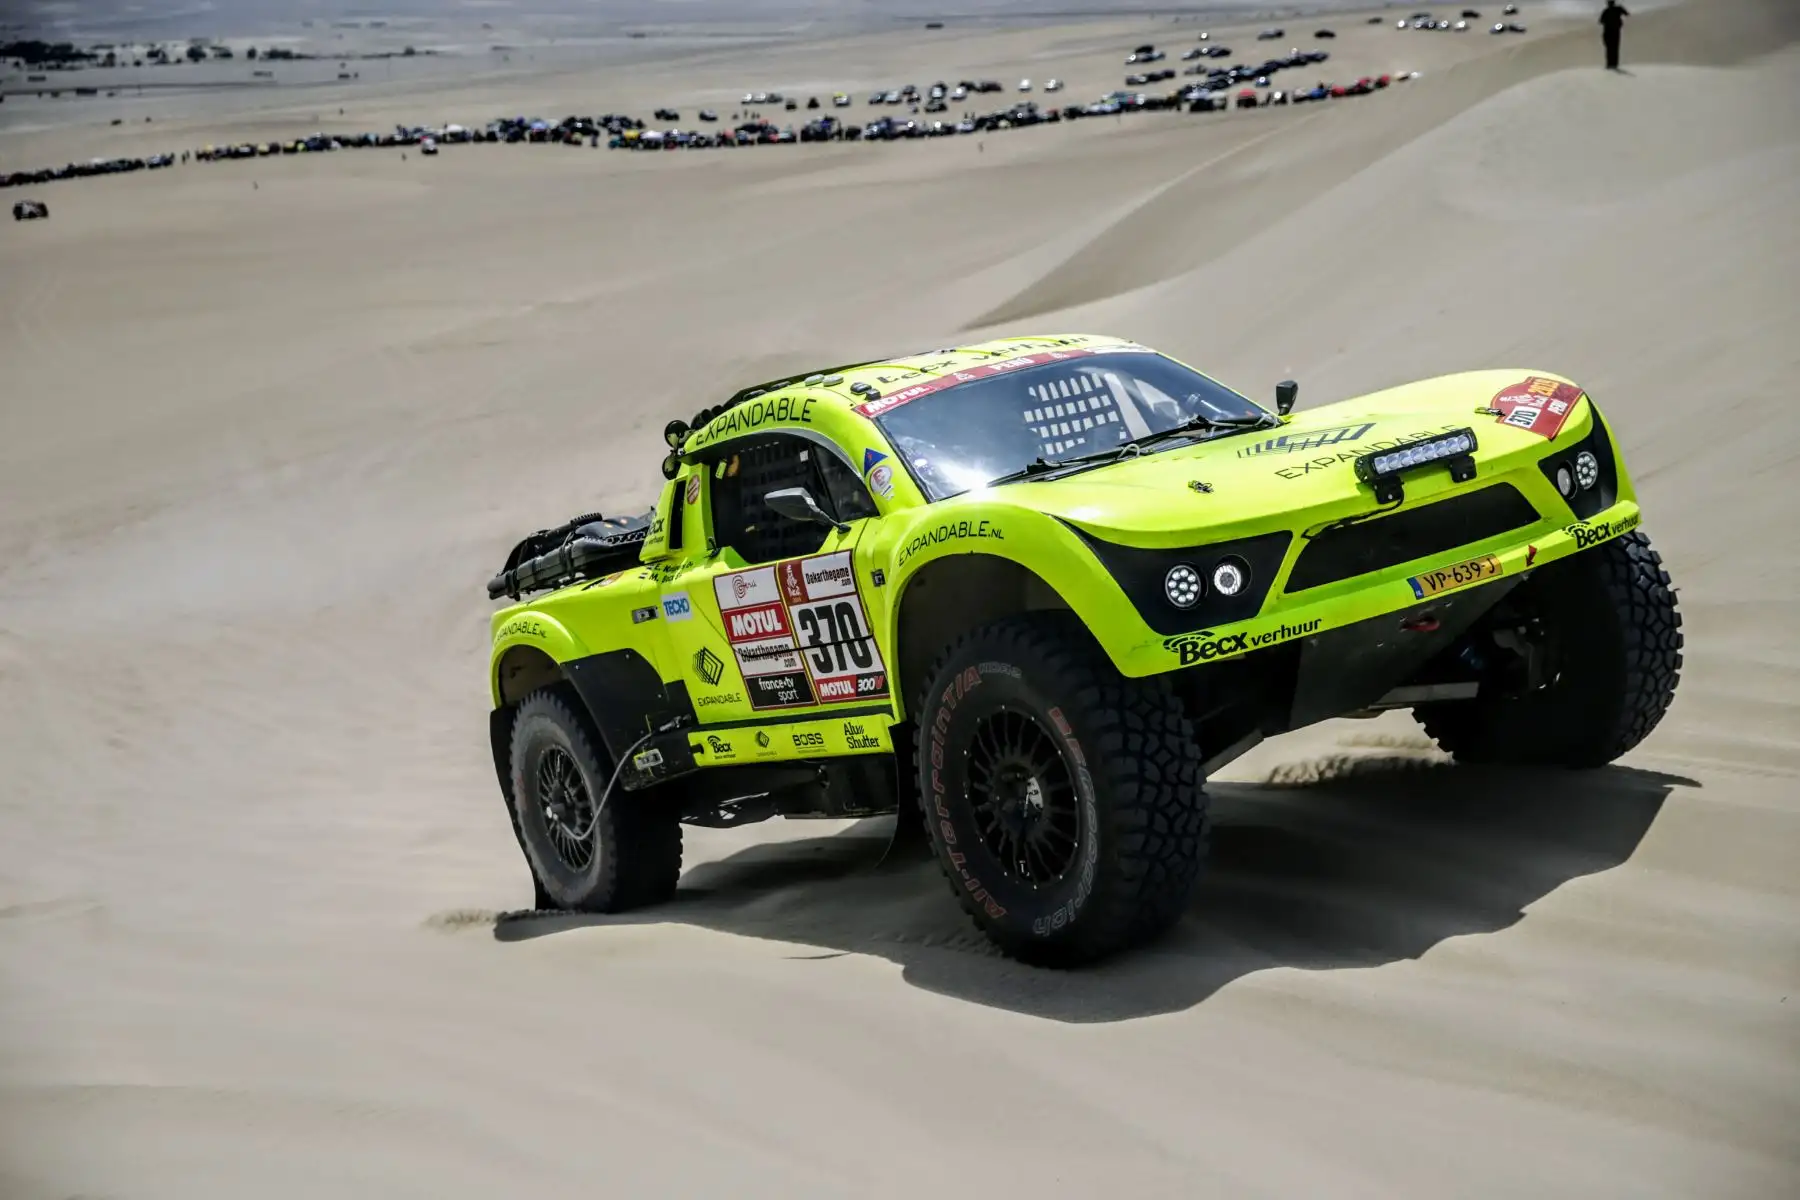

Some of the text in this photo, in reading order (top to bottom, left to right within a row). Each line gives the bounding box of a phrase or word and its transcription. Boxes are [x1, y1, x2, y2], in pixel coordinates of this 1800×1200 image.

[866, 386, 931, 414] MOTUL
[696, 397, 817, 446] EXPANDABLE
[1508, 410, 1538, 427] 370
[898, 520, 1005, 567] EXPANDABLE.NL
[1573, 522, 1611, 549] Becx
[1423, 557, 1495, 591] VP-639-J
[730, 608, 783, 637] MOTUL
[798, 601, 873, 674] 370
[1179, 618, 1322, 666] Becx verhuur
[777, 689, 800, 704] sport
[819, 675, 884, 697] MOTUL 300V
[697, 693, 743, 707] EXPANDABLE
[712, 741, 733, 754] Becx
[792, 733, 824, 747] BOSS
[846, 735, 880, 749] Shutter
